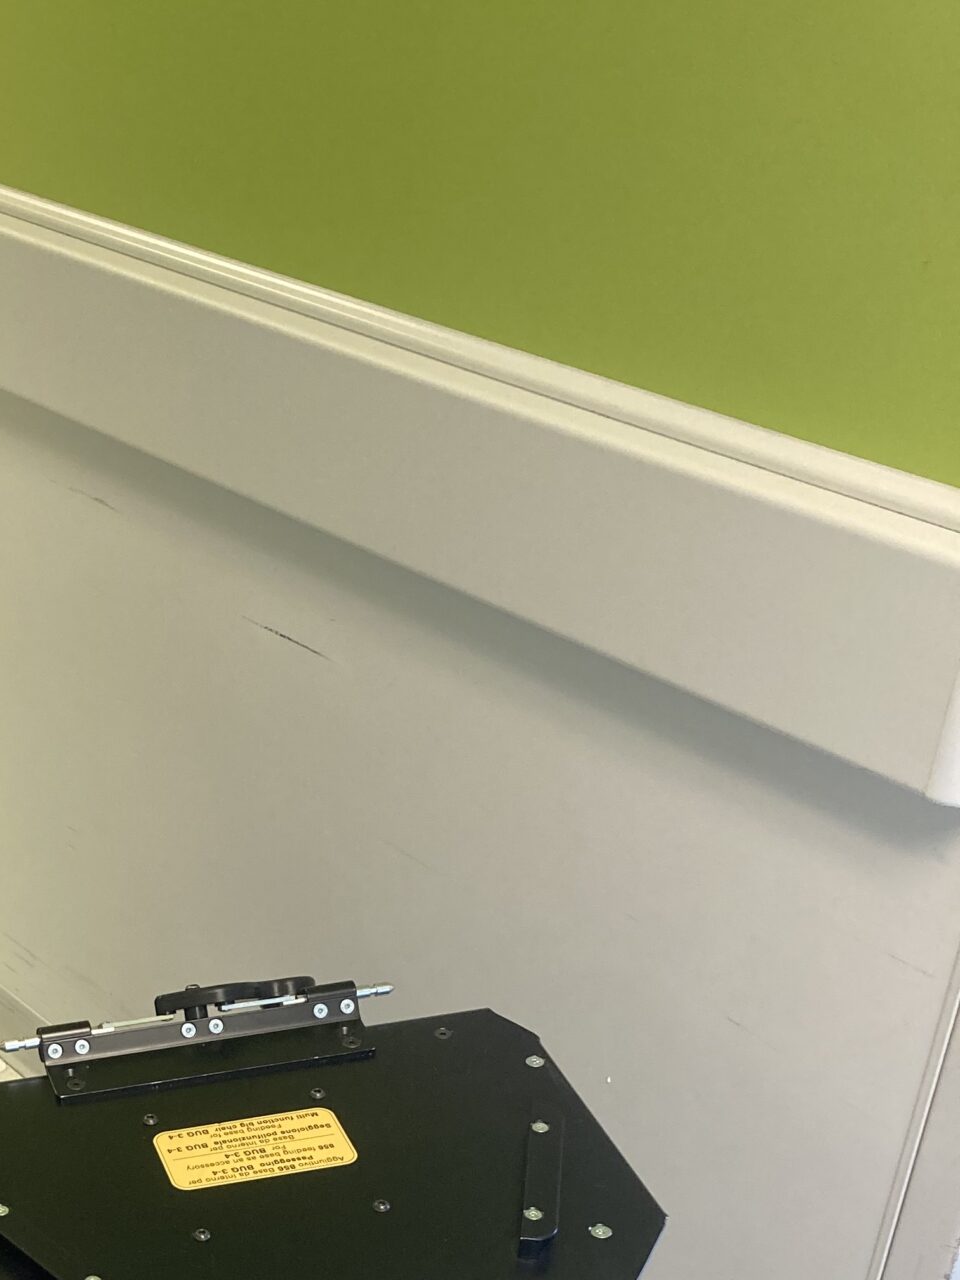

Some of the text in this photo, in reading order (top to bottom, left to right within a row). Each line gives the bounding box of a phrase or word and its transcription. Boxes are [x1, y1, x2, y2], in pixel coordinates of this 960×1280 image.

[257, 1116, 294, 1125] function
[246, 1124, 281, 1132] Feeding
[280, 1123, 331, 1135] Seggiolone
[214, 1131, 277, 1146] polifunzionale
[259, 1151, 280, 1159] base
[283, 1146, 315, 1155] feeding
[187, 1161, 230, 1170] accessory
[260, 1155, 313, 1167] Passeggino
[298, 1156, 344, 1167] Aggiuntivo
